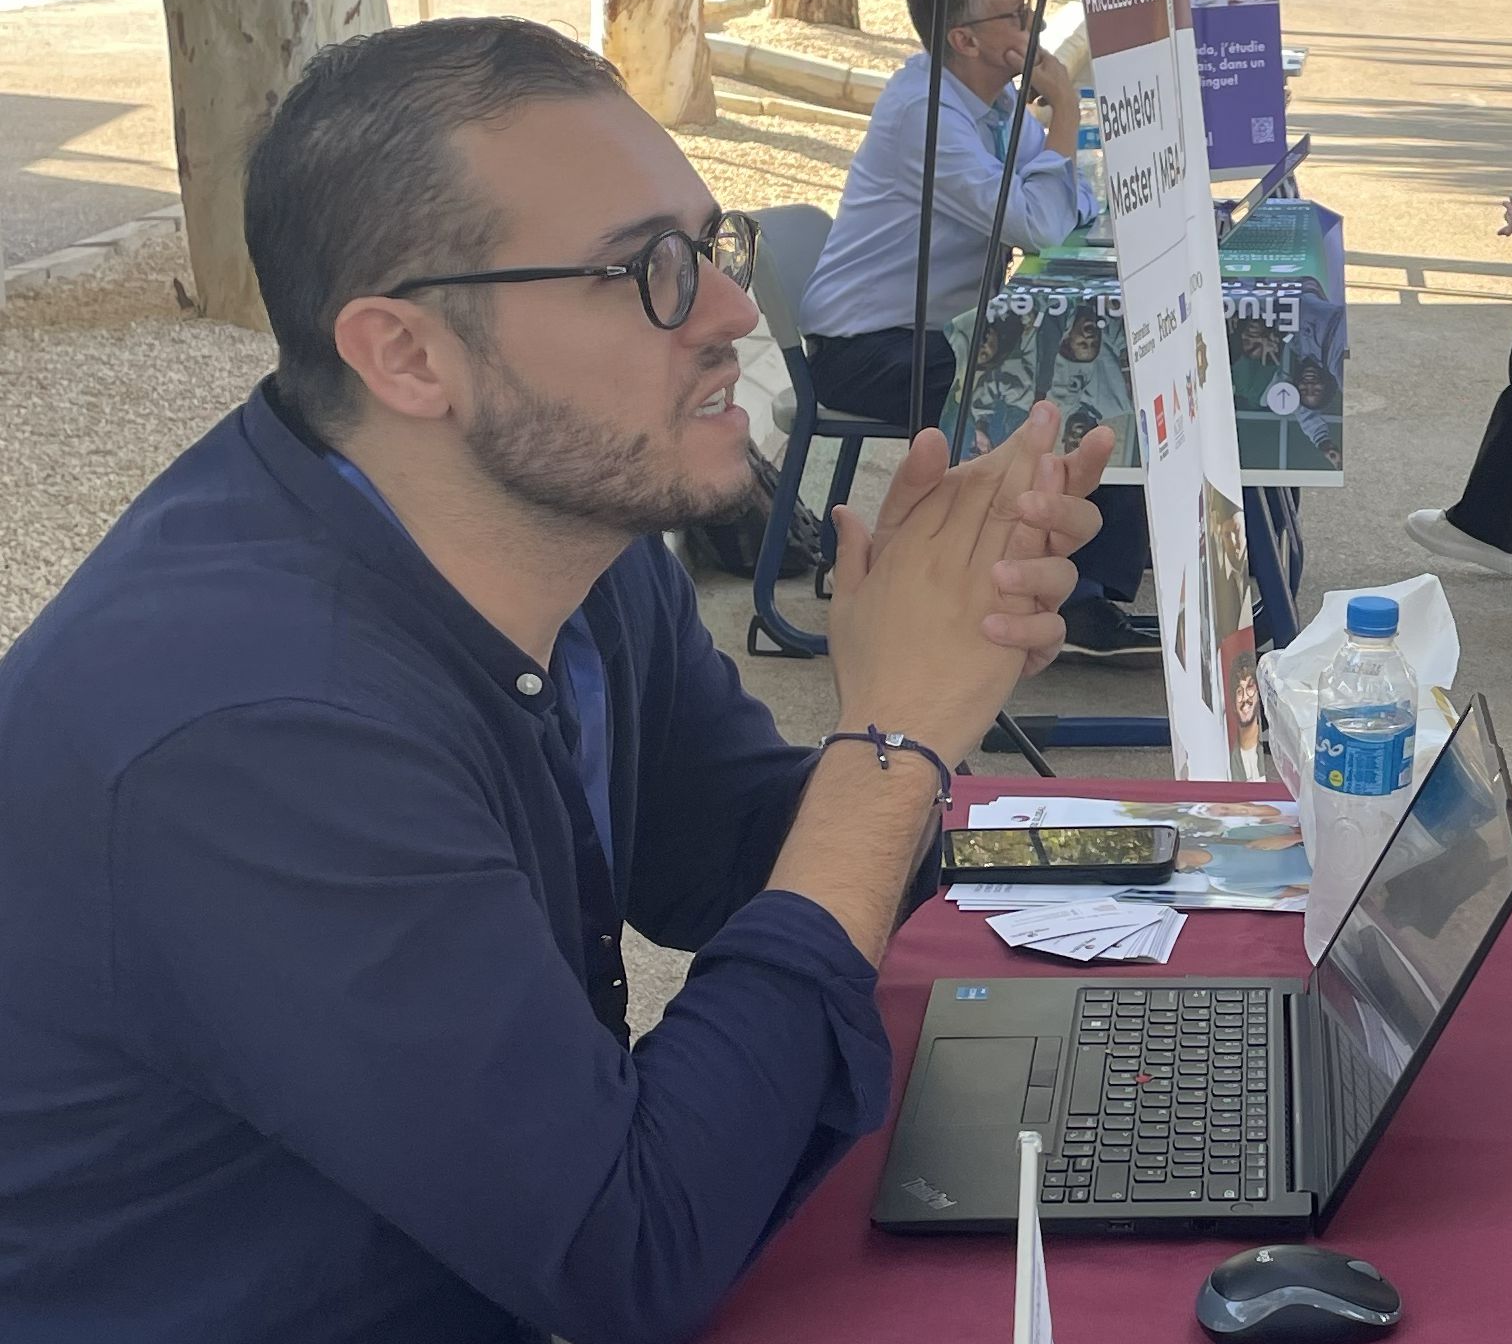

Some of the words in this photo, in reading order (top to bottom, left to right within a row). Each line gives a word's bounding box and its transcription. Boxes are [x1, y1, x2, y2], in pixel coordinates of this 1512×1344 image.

[1219, 58, 1248, 70] dans
[1250, 59, 1265, 69] un
[1100, 80, 1156, 142] Bachelor
[1110, 165, 1152, 220] Master
[1158, 142, 1181, 194] MBA
